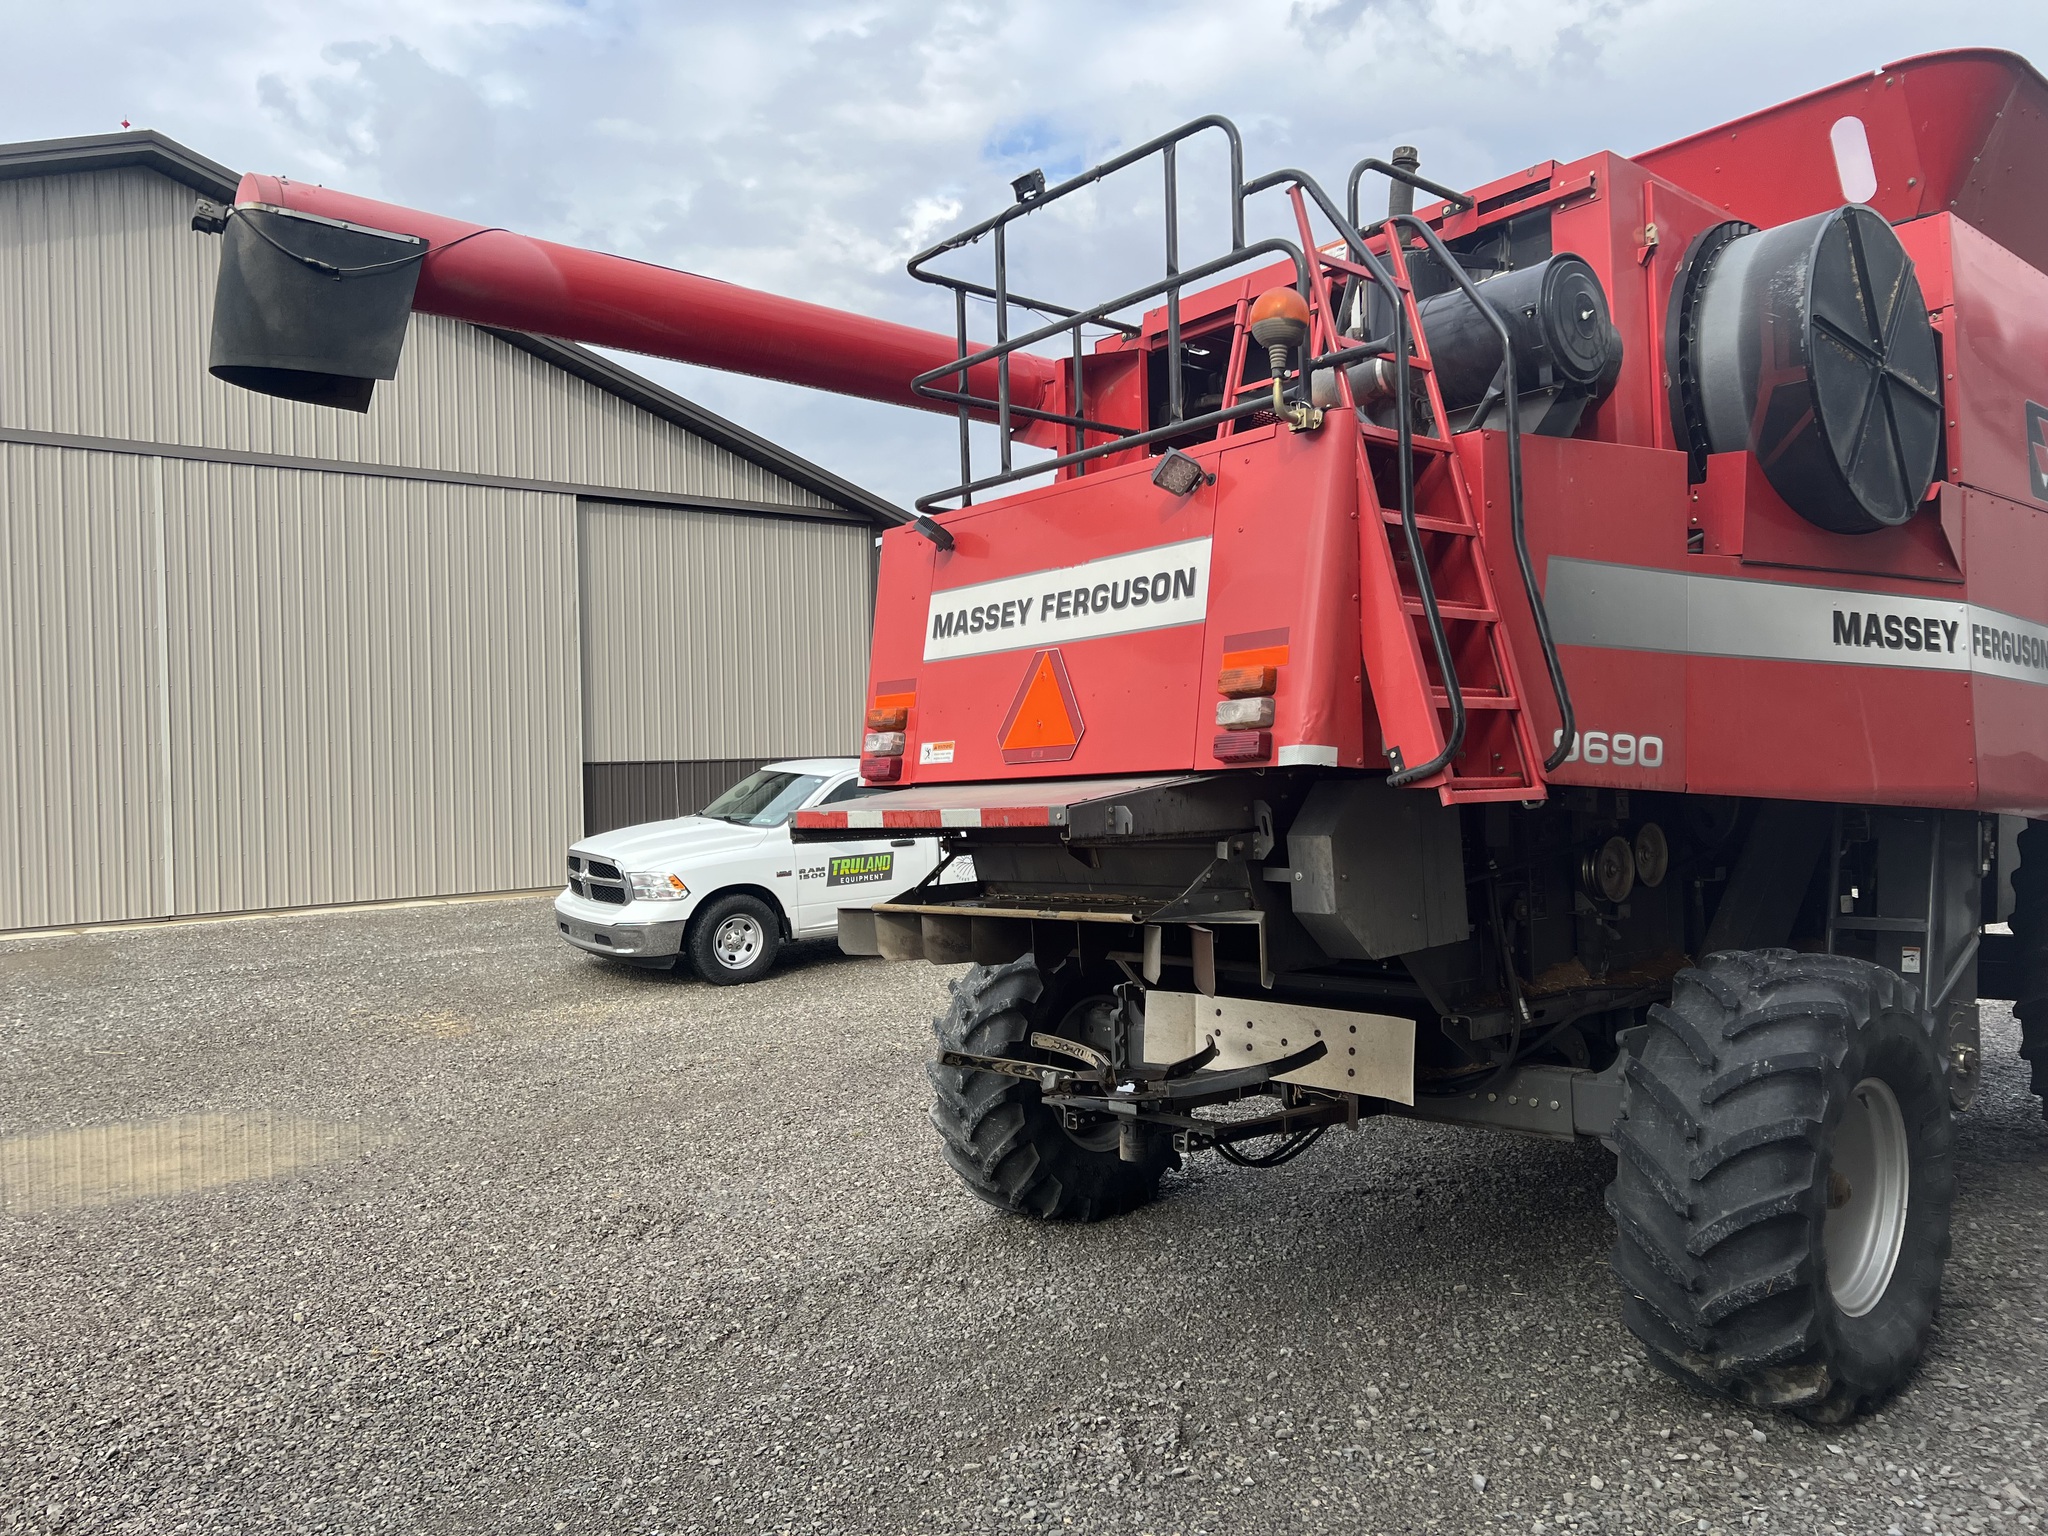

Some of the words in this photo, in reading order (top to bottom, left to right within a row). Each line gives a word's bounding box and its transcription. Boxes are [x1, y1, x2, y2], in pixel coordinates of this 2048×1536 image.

[932, 597, 1033, 640] MASSEY
[1040, 567, 1197, 622] FERGUSON
[1833, 610, 1959, 654] MASSEY
[1972, 623, 2048, 669] FERGUSON
[798, 866, 826, 875] RAM
[831, 854, 891, 876] TRULAND
[799, 872, 826, 880] 1500
[840, 873, 884, 884] EQUIPMENT
